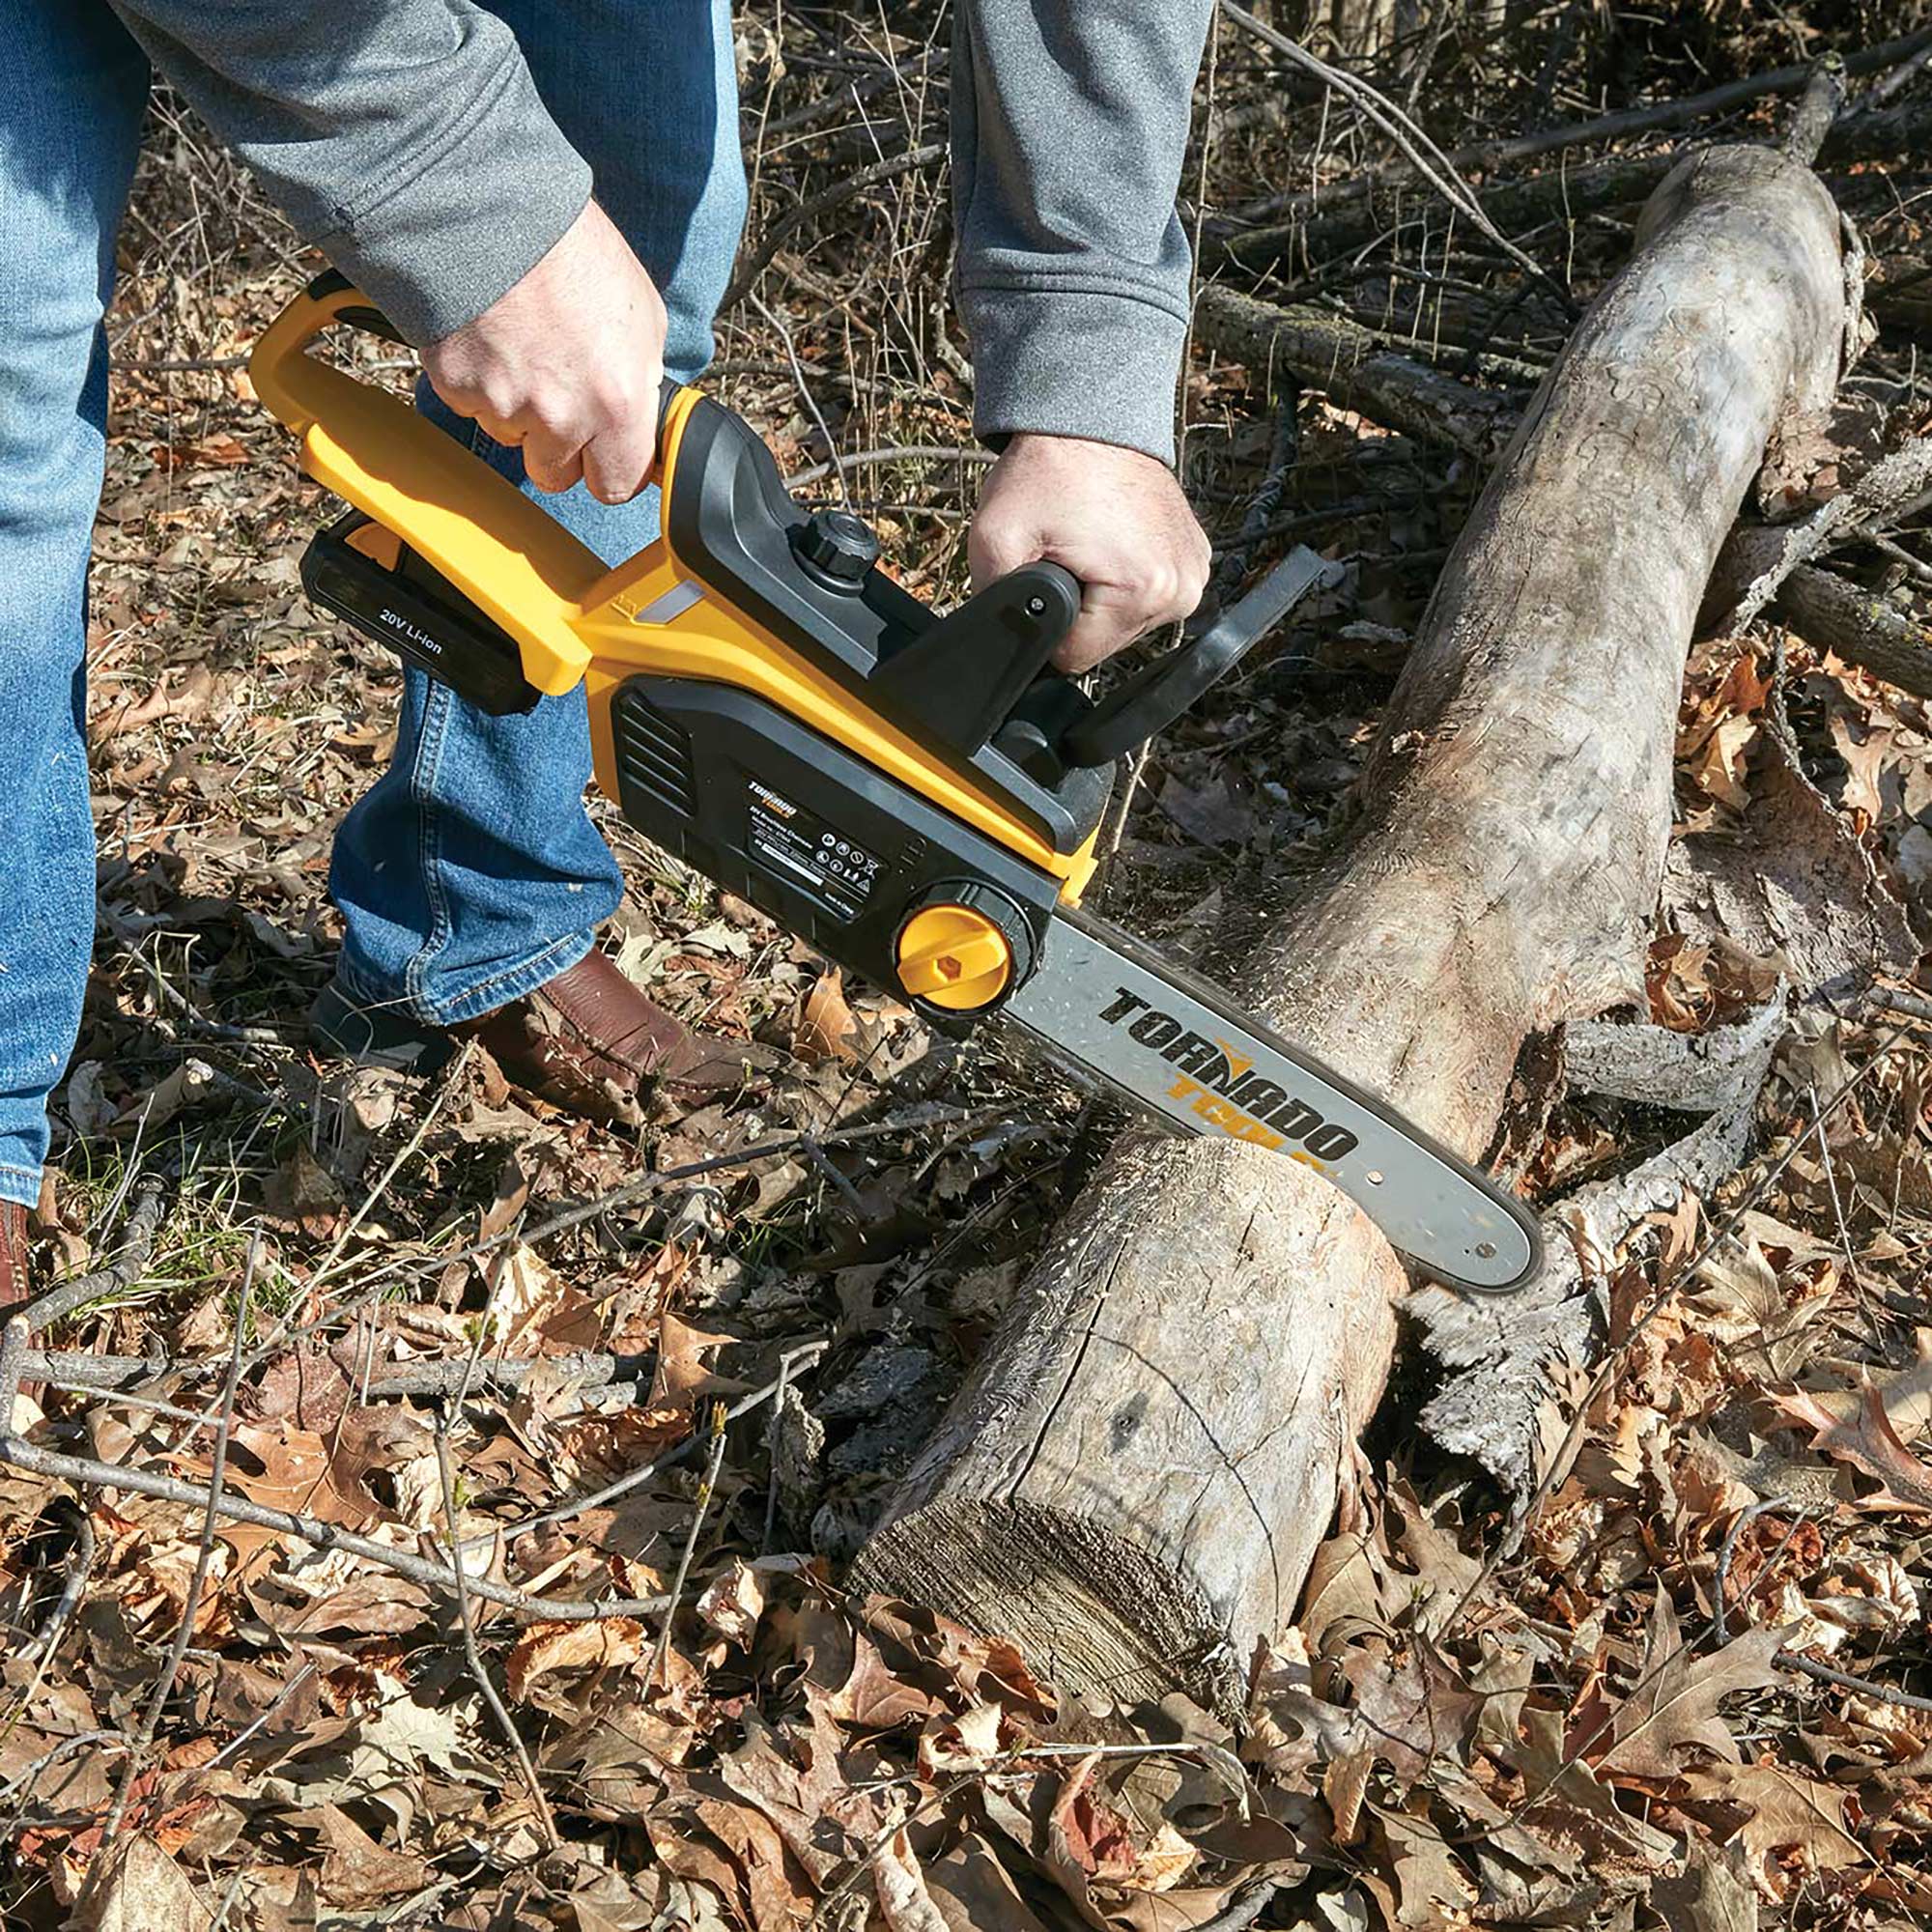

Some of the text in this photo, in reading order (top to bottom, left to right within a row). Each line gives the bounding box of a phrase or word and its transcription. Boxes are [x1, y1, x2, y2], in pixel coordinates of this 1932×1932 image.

[379, 609, 442, 655] 20V Li-ion
[1098, 986, 1359, 1161] TORNADO
